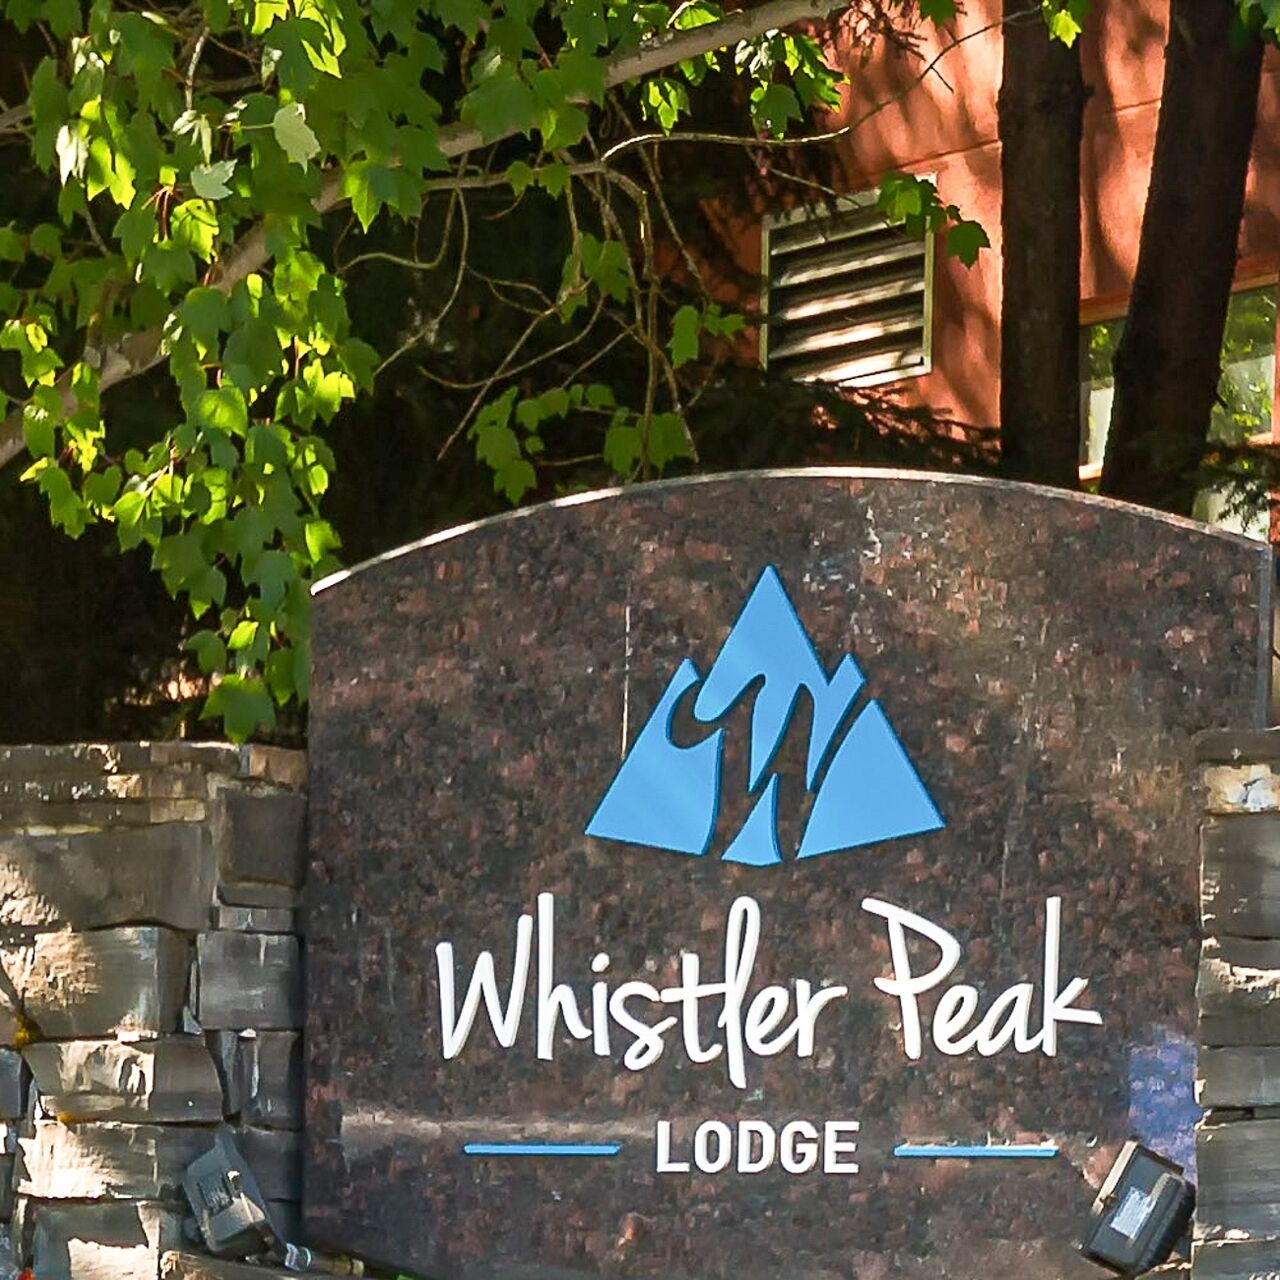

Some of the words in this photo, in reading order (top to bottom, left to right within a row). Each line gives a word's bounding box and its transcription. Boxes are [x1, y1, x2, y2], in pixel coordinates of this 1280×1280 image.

[435, 892, 847, 1089] Whistler
[861, 895, 1103, 1060] Peak
[655, 1119, 860, 1175] LODGE
